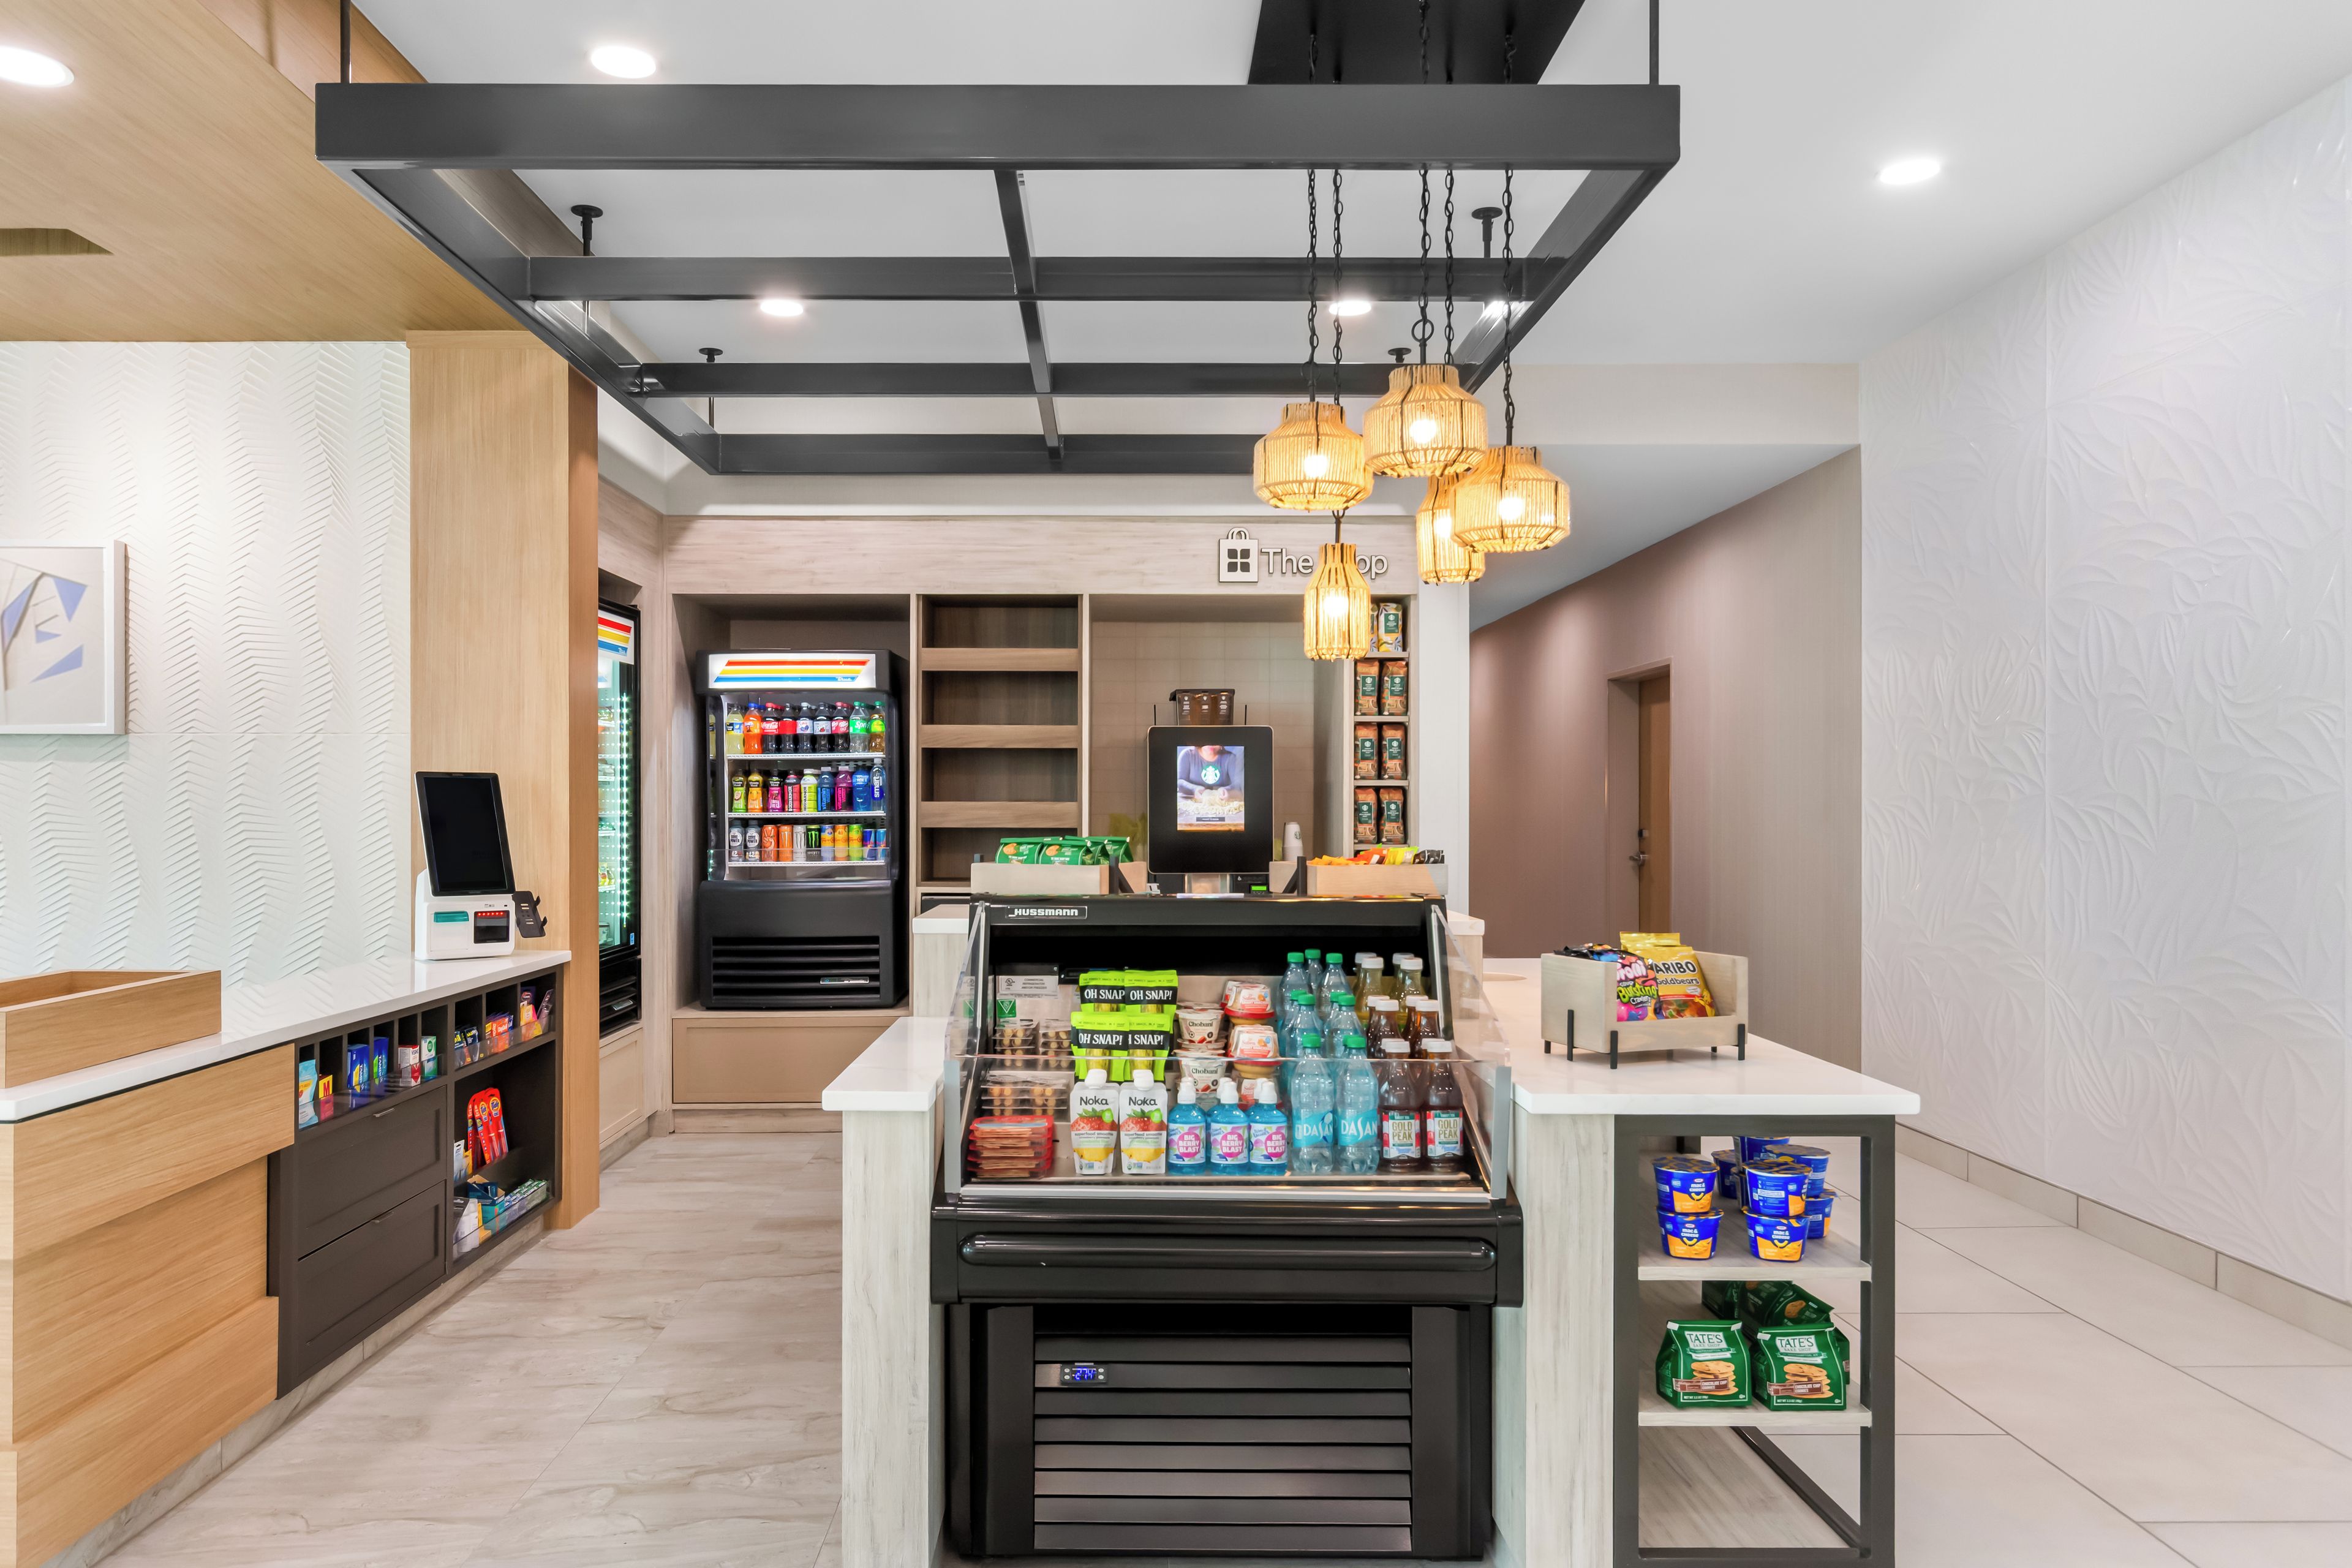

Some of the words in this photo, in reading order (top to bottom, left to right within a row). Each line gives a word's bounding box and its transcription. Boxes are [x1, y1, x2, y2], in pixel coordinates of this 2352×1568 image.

[1261, 548, 1314, 574] The
[1654, 961, 1697, 974] ARIBO
[1084, 989, 1097, 999] OH
[1129, 990, 1144, 1000] OH
[1145, 990, 1172, 1000] SNAP!
[1617, 982, 1657, 1003] Bursting
[1079, 1033, 1091, 1044] OH
[1093, 1034, 1123, 1045] SNAP!
[1134, 1034, 1164, 1045] SNAP!
[1080, 1096, 1109, 1106] Noka
[1129, 1096, 1158, 1106] Noka
[1392, 1121, 1412, 1131] GOLD
[1438, 1119, 1458, 1129] GOLD
[1392, 1131, 1412, 1141] PEAK
[1438, 1129, 1458, 1139] PEAK
[1687, 1333, 1723, 1343] TATE'S
[1777, 1337, 1814, 1348] TATE'S
